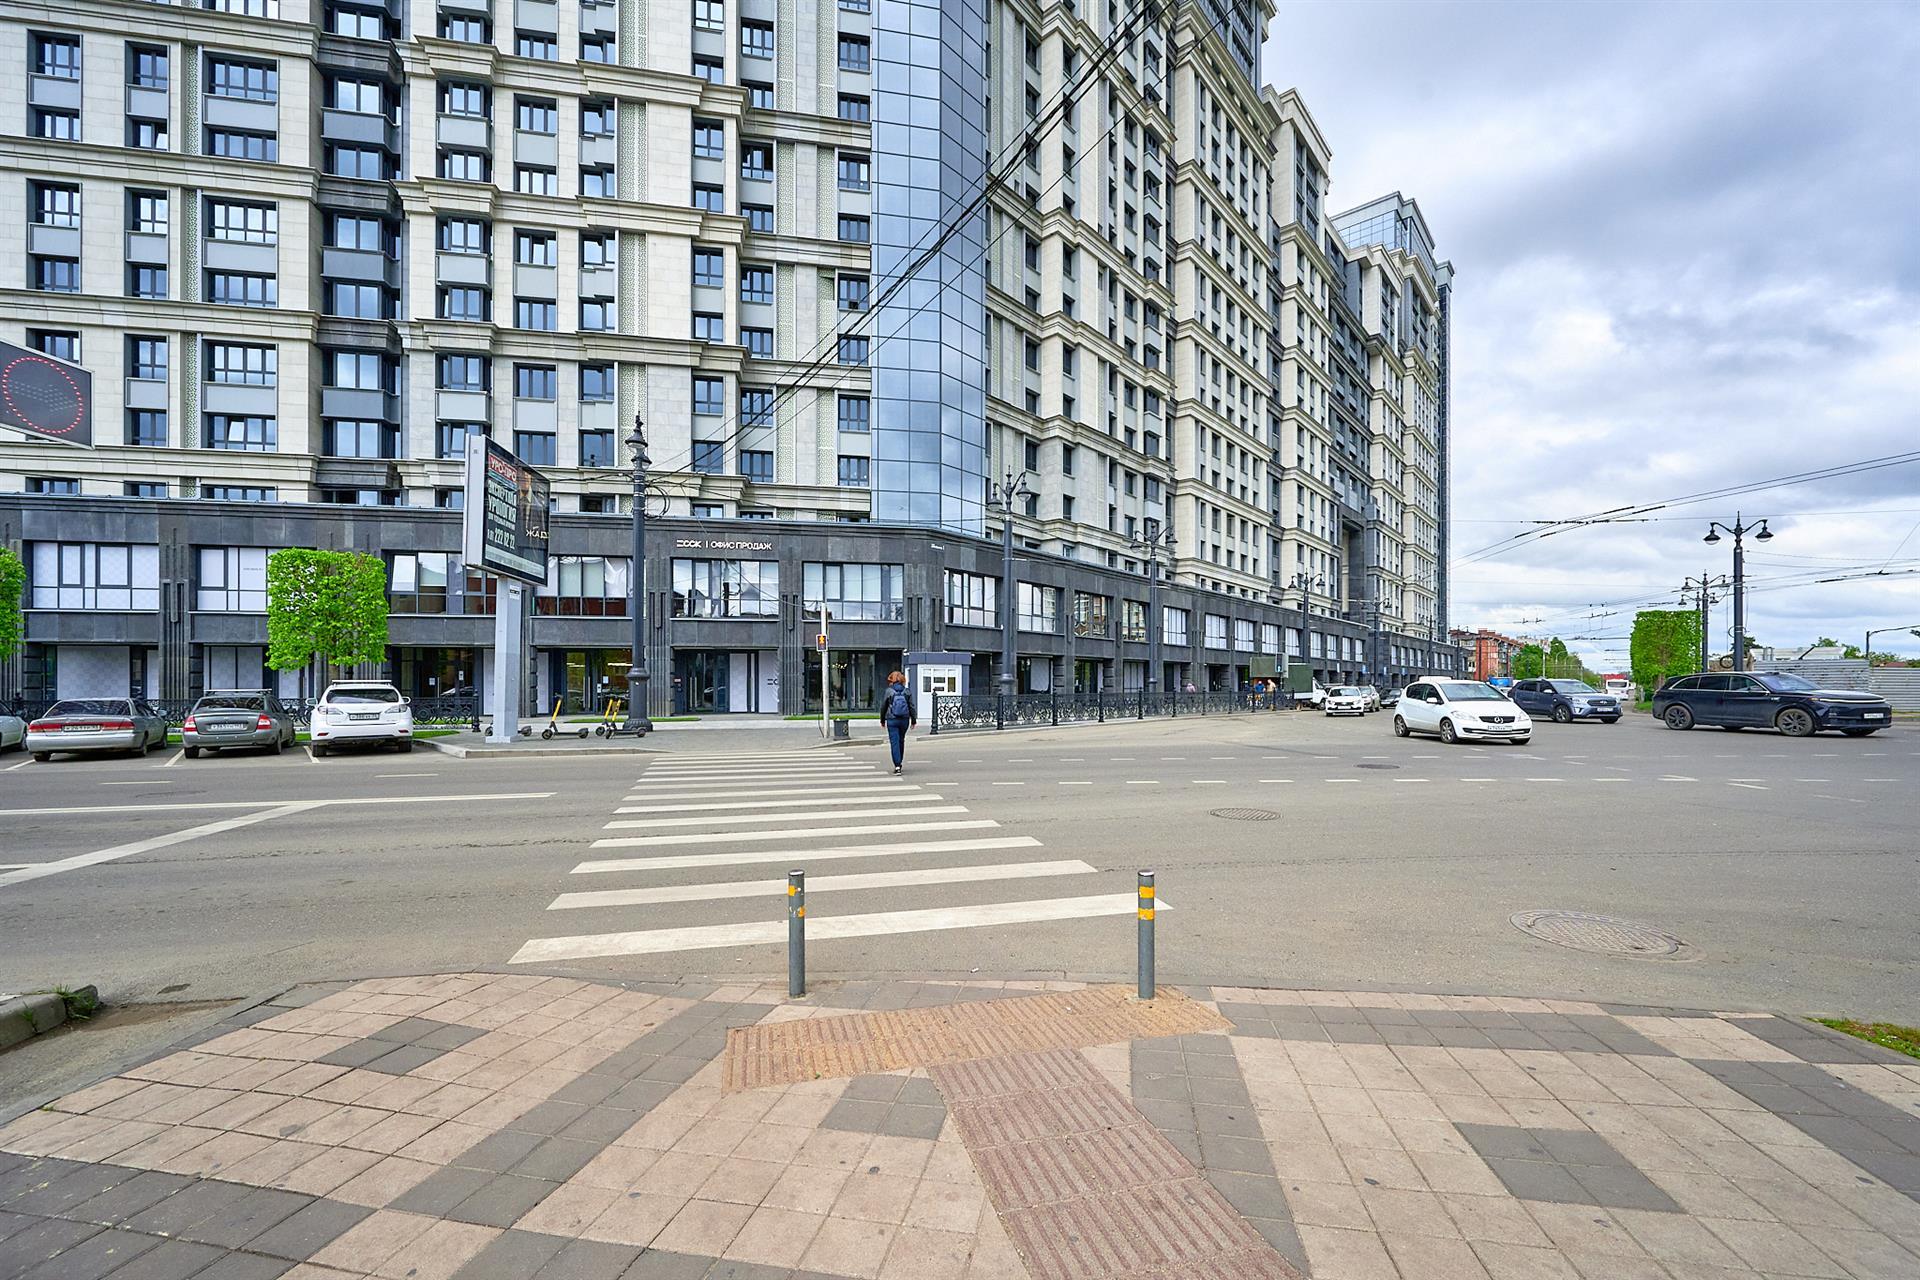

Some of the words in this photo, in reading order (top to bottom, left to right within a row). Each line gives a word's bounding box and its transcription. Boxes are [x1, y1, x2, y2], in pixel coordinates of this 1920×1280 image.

[488, 493, 516, 523] УРОЛОГИЯ
[710, 541, 735, 549] ОФИС
[736, 542, 772, 551] ПРОДАЖ
